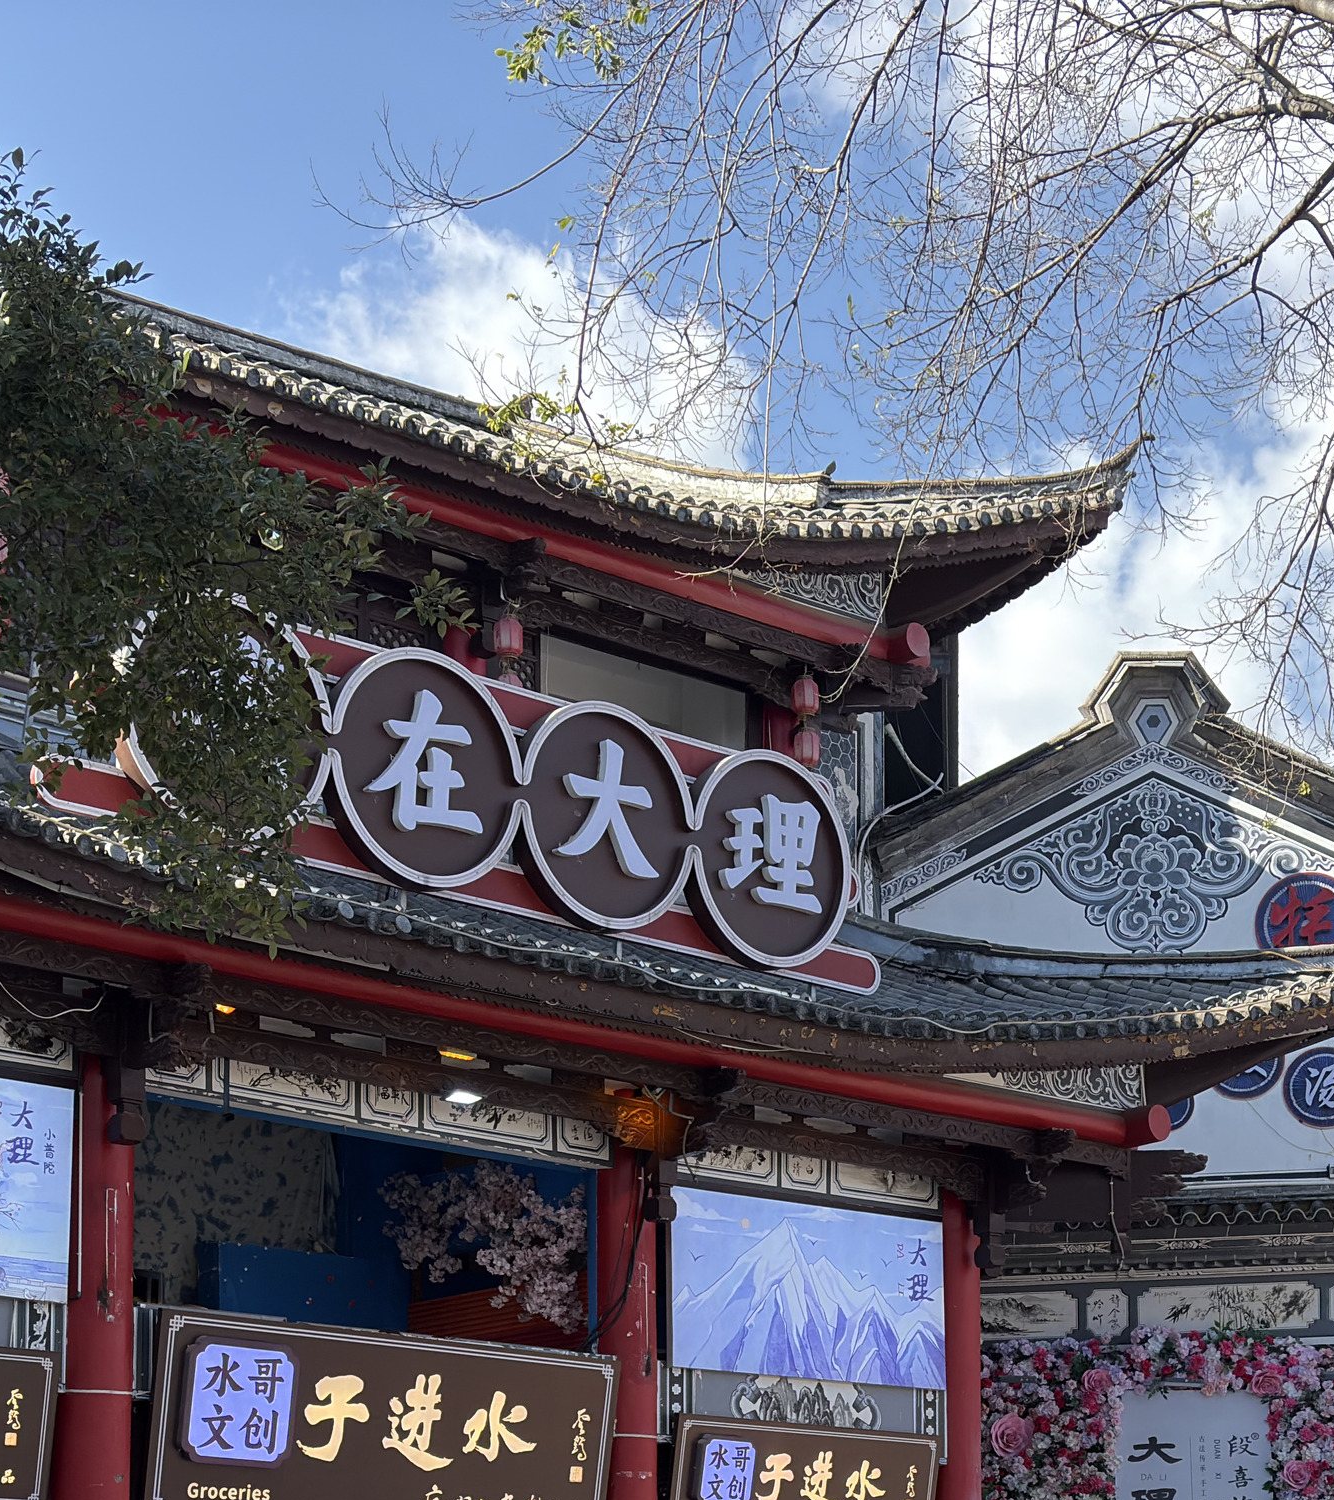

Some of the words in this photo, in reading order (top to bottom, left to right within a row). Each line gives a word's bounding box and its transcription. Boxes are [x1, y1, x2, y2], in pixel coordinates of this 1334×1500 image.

[9, 1101, 40, 1166] 大理
[43, 1129, 56, 1175] 小普陀
[906, 1239, 934, 1302] 大理
[201, 1352, 285, 1403] 水哥
[196, 1404, 279, 1455] 文创
[296, 1373, 538, 1472] 子进水
[709, 1443, 751, 1474] 水哥
[1213, 1439, 1221, 1459] DUAN
[1140, 1473, 1154, 1481] DA
[1159, 1473, 1168, 1481] LI
